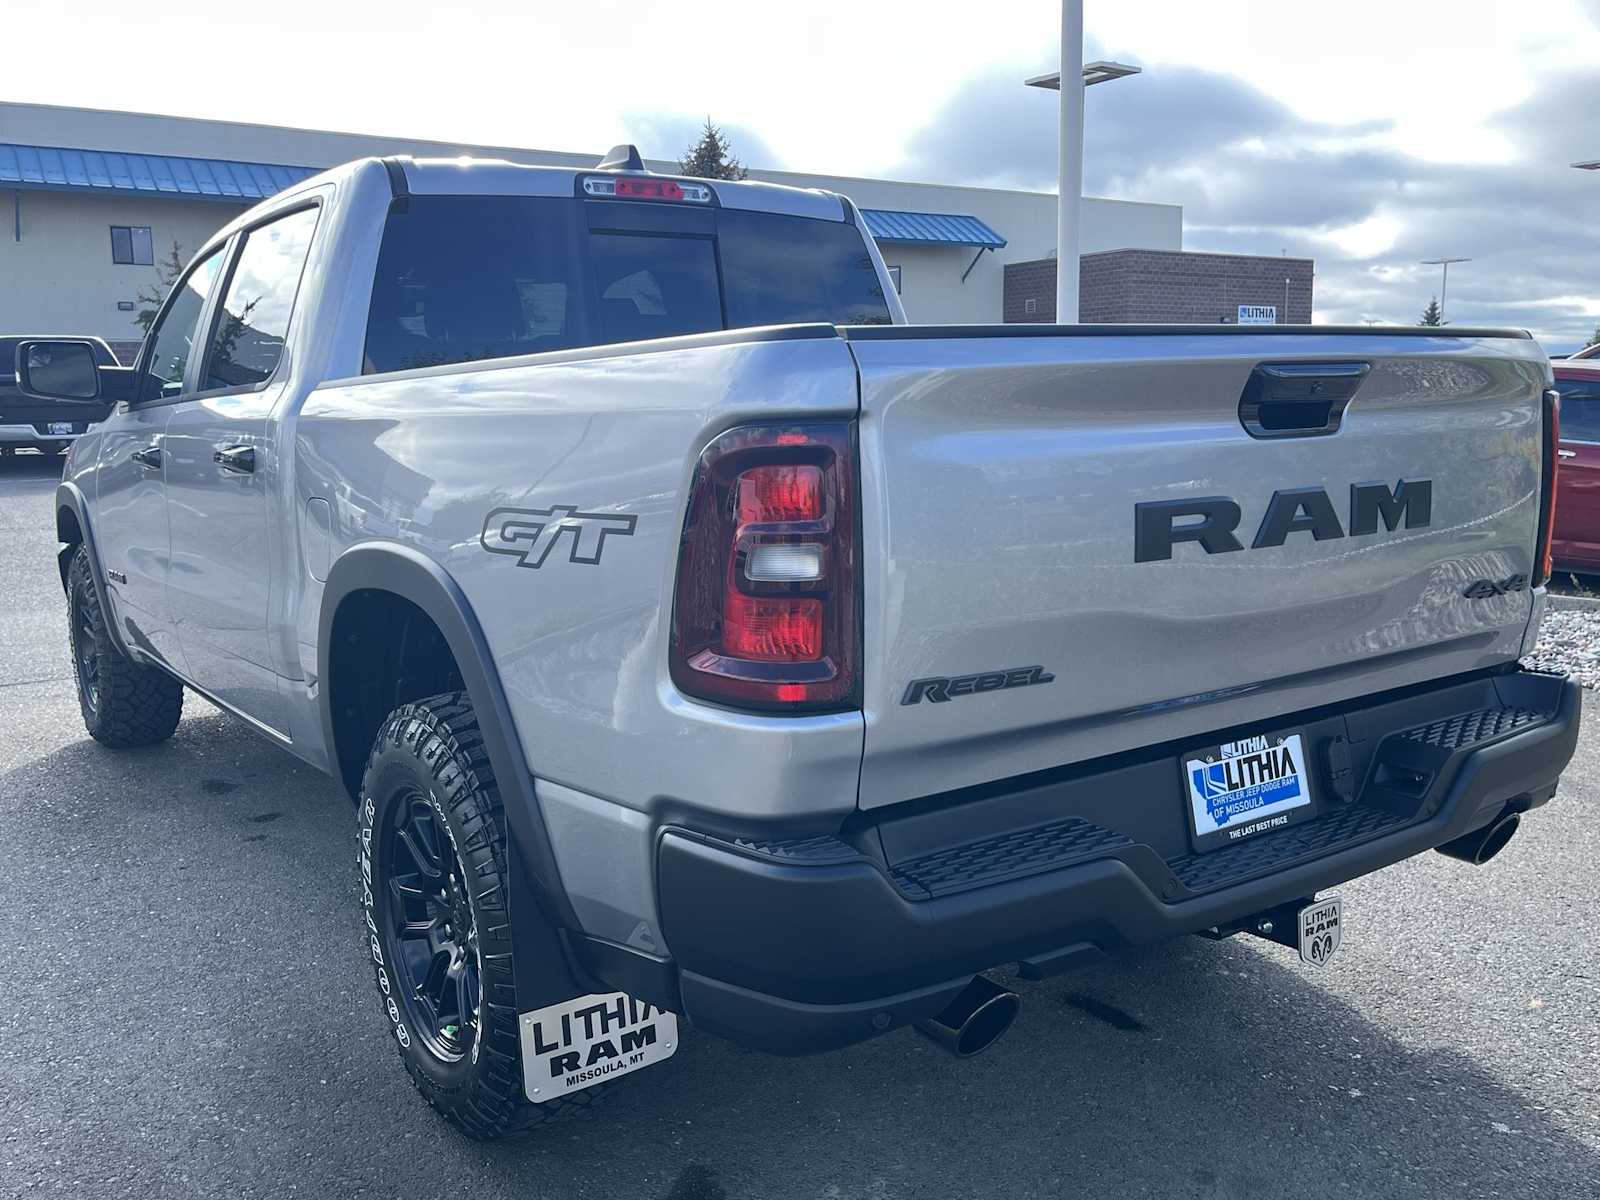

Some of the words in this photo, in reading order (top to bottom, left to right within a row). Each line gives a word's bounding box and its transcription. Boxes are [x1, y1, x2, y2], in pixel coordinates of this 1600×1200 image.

[1247, 307, 1274, 318] LITHIA
[1134, 477, 1433, 563] RAM
[901, 665, 1056, 706] REBEL
[1231, 735, 1269, 757] LITHIA
[1225, 747, 1297, 792] LITHIA
[1212, 789, 1246, 807] CHRYSLER
[1246, 787, 1260, 798] JEEP
[1261, 782, 1281, 793] DODGE
[1282, 777, 1296, 788] RAM
[1213, 807, 1225, 819] OF
[1226, 796, 1265, 816] MISSOULA
[1229, 830, 1242, 839] THE
[1241, 824, 1256, 836] LAST
[1256, 819, 1271, 831] BEST
[1271, 815, 1288, 828] PRICE
[361, 798, 411, 1048] GOODYEAR
[1306, 906, 1337, 926] LITHIA
[1306, 917, 1338, 936] RAM
[550, 1024, 657, 1078] RAM
[566, 1059, 627, 1087] MISSOULA,
[629, 1052, 645, 1066] MT
